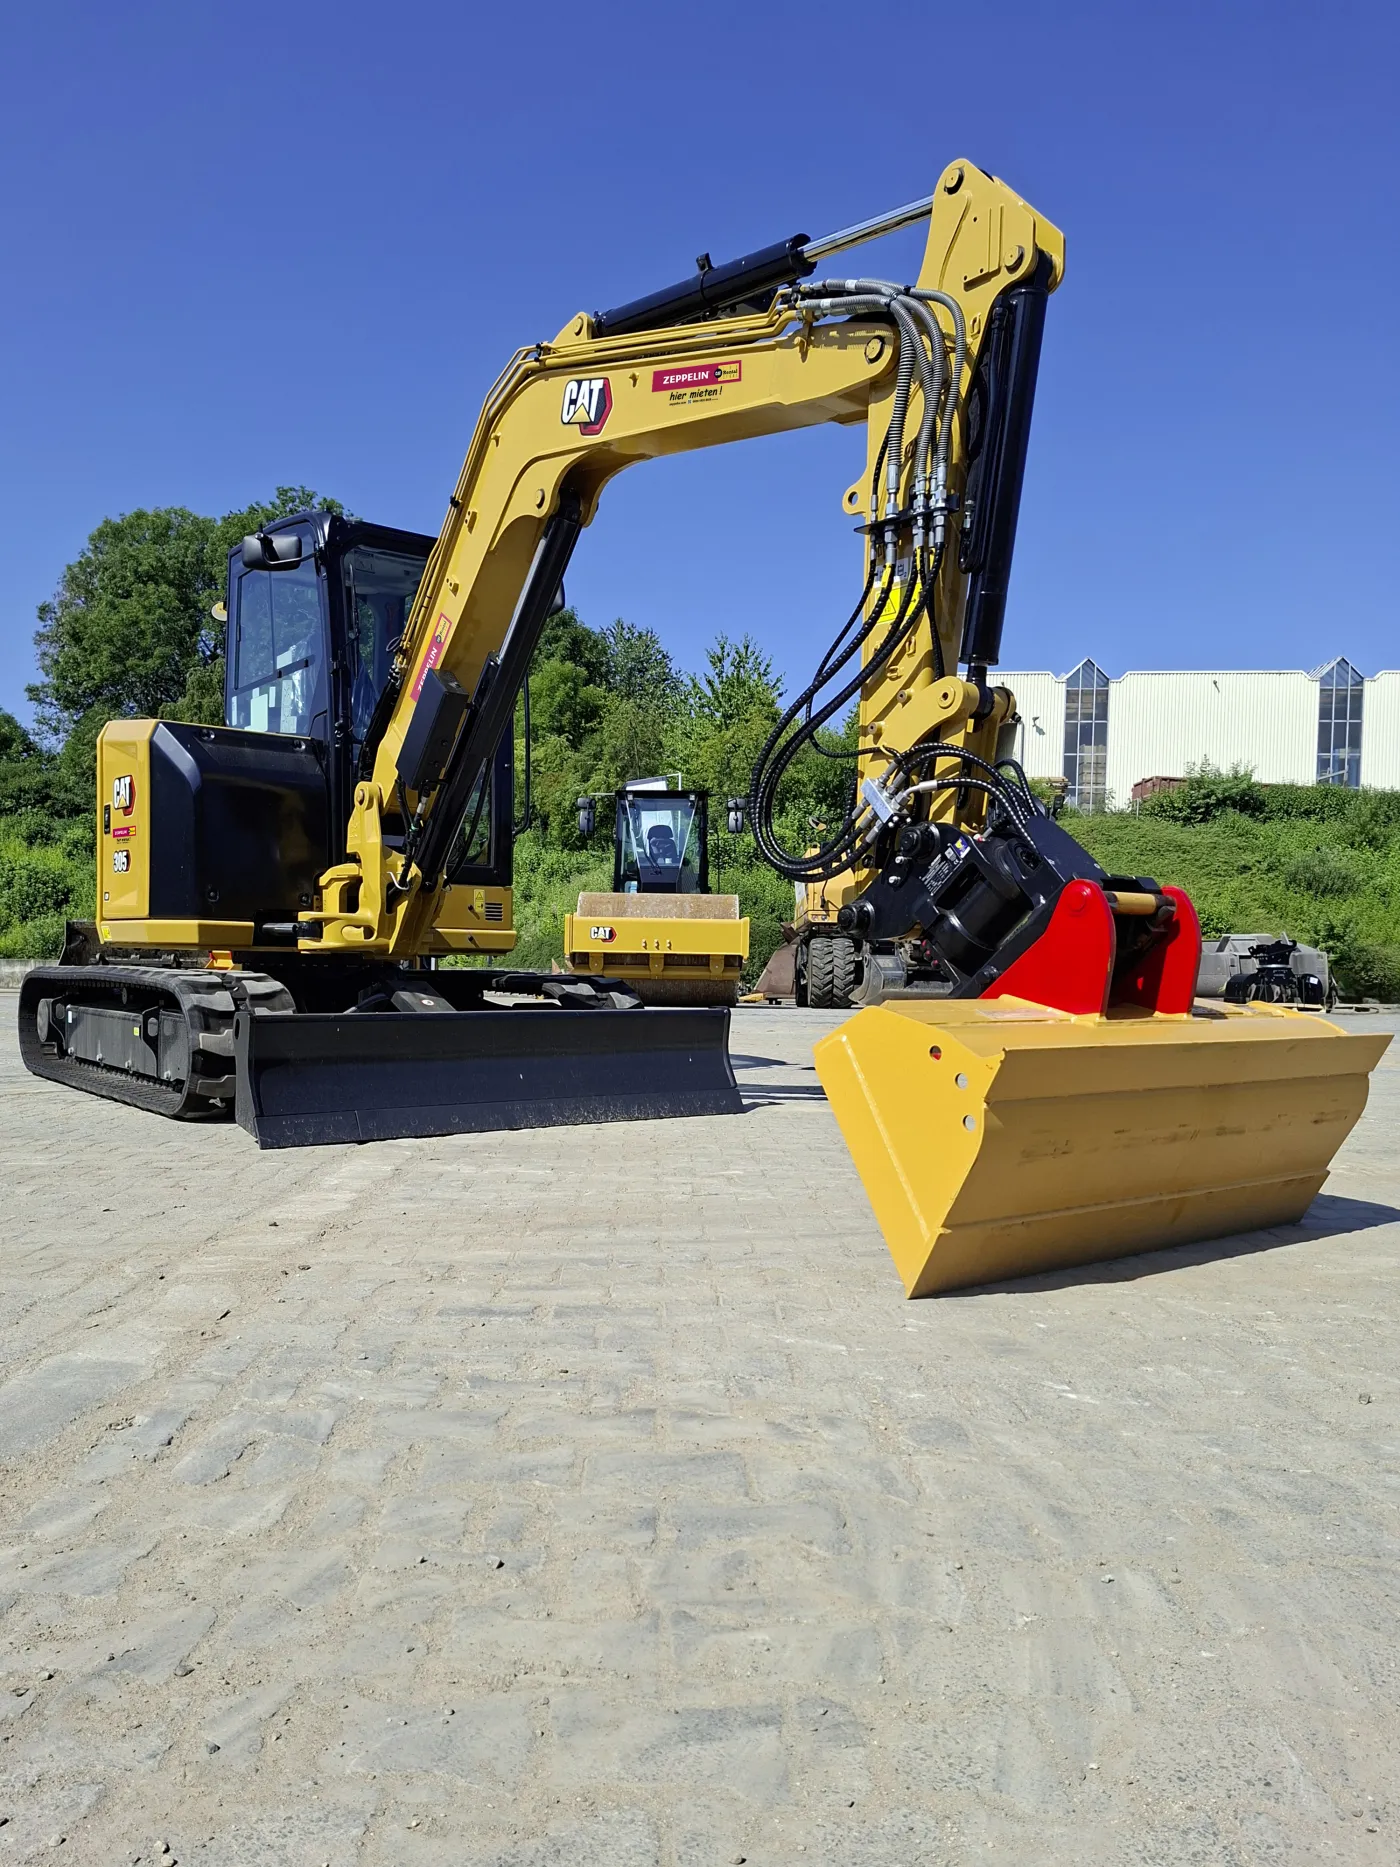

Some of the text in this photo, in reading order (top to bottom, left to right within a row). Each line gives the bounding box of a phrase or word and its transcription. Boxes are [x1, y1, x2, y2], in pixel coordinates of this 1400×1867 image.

[662, 370, 710, 385] ZEPPELIN
[562, 379, 604, 423] CAT
[669, 391, 687, 401] hier
[114, 775, 131, 810] CAT
[113, 850, 128, 873] 305
[590, 926, 611, 940] CAT
